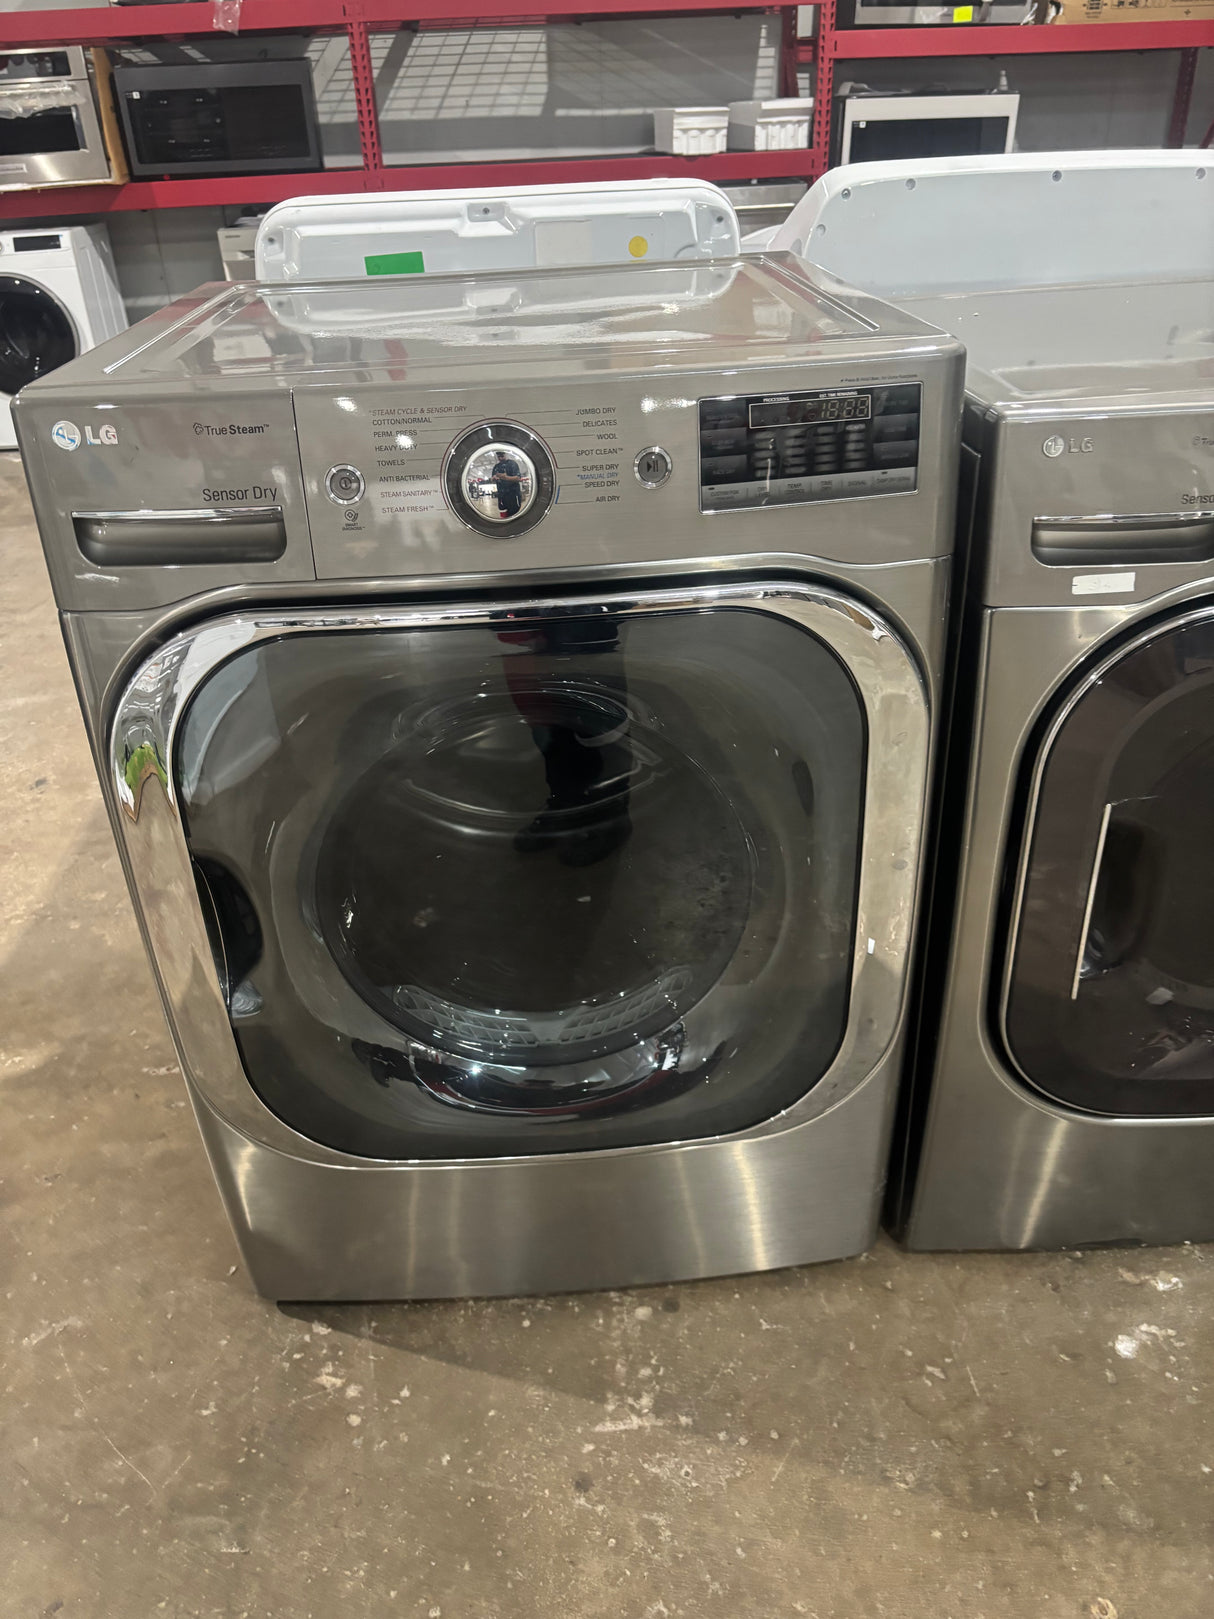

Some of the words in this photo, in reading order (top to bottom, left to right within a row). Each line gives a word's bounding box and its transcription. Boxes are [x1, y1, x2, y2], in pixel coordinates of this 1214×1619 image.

[426, 406, 453, 414] SENSOR
[575, 408, 601, 416] JUMBO
[372, 417, 432, 426] COTTON/NORMAL
[582, 419, 618, 428] DELICATES
[84, 424, 118, 445] LG
[1068, 437, 1095, 453] LG
[576, 449, 595, 457] SPOT
[377, 459, 406, 467] TOWELS
[582, 464, 604, 472] SUPER
[379, 475, 396, 483] ANTI
[395, 474, 431, 482] BACTERIAL
[202, 488, 249, 502] Sensor
[252, 485, 277, 502] Dry
[382, 506, 405, 514] STEAM
